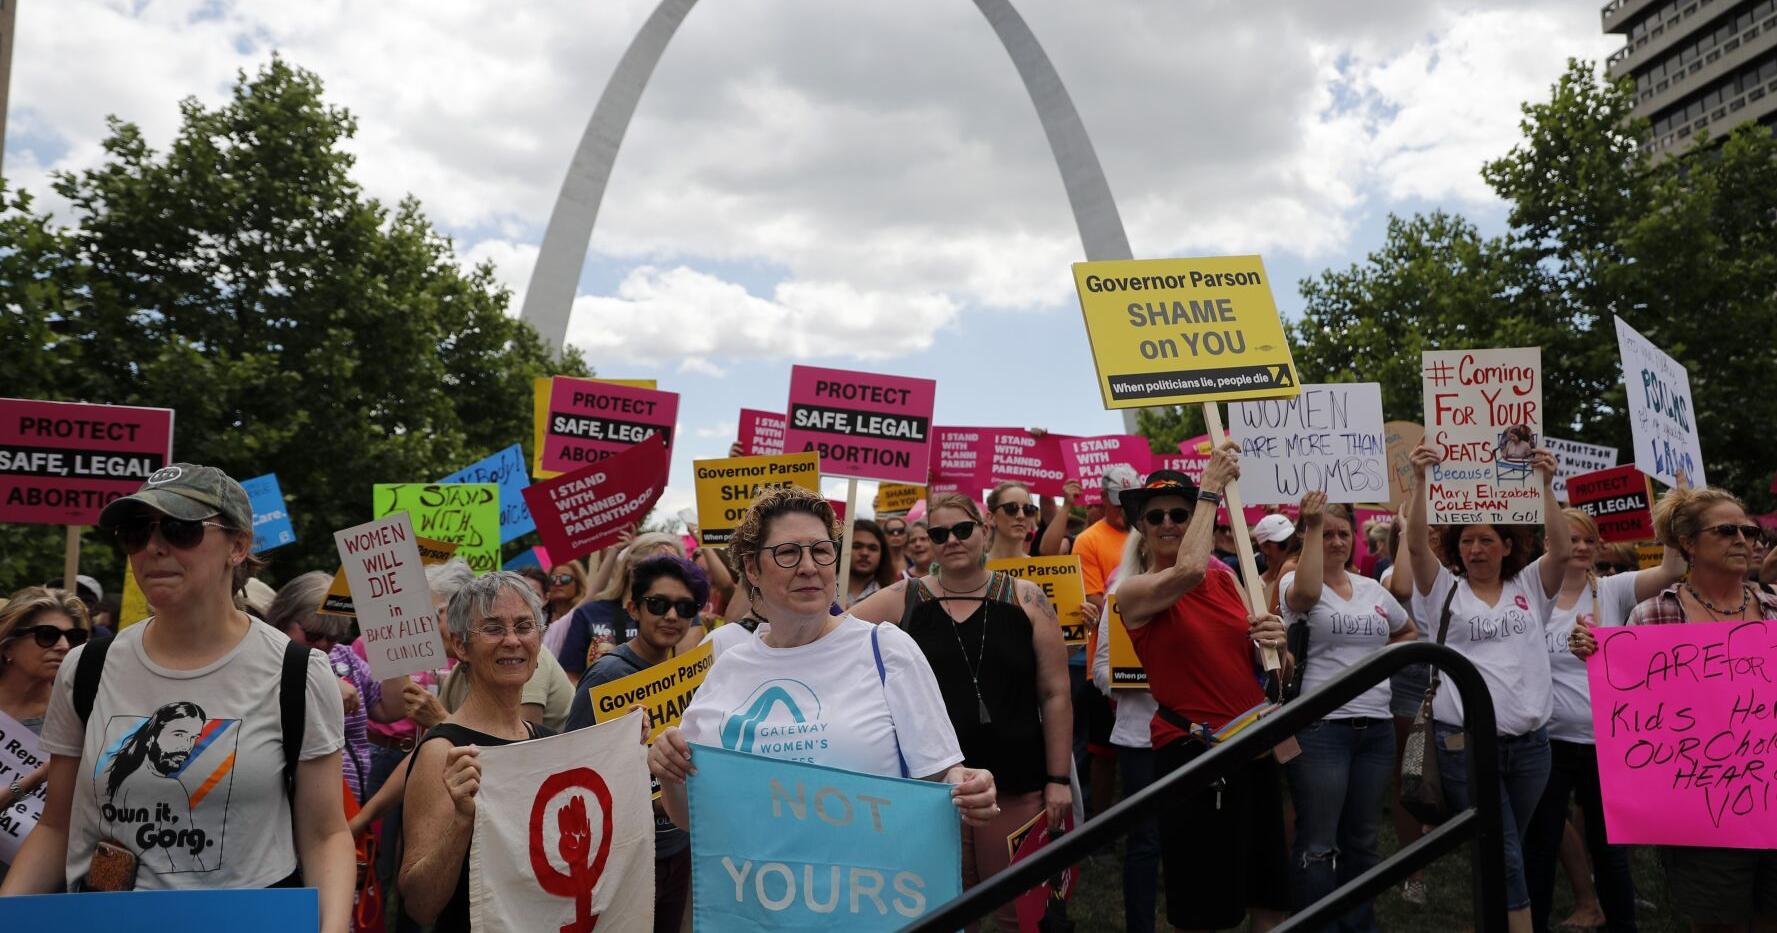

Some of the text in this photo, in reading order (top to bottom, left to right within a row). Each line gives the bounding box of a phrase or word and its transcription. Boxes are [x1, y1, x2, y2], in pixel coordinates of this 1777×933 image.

[1086, 271, 1262, 293] Governor Parson
[1127, 298, 1237, 327] SHAME
[1139, 330, 1246, 360] on YOU
[815, 380, 911, 406] PROTECT
[1113, 373, 1269, 394] When politicians lie, people die
[573, 391, 657, 416] PROTECT
[1241, 389, 1348, 430] WOMEN
[19, 416, 141, 442] PROTECT
[553, 416, 657, 443] SAFE, LEGA
[755, 427, 783, 438] WITH
[762, 418, 786, 429] STAN
[794, 408, 923, 439] SAFE, LEGAL
[942, 442, 967, 450] WITH
[948, 433, 979, 441] STAND
[995, 435, 1036, 447] I STAND
[1073, 439, 1120, 453] I STAND
[1242, 436, 1280, 459] ARE
[1285, 433, 1335, 457] MORE
[1340, 432, 1383, 456] THAN
[802, 441, 910, 469] ABORTION
[995, 444, 1023, 455] WITH
[1076, 452, 1110, 465] WITH
[1558, 442, 1611, 459] ABORTION
[0, 451, 153, 478] SAFE, LEGAL
[698, 462, 816, 480] Governor Parson
[992, 464, 1064, 480] PARENTHOOD
[993, 455, 1042, 468] PLANNED
[1164, 459, 1210, 470] I STAN
[1433, 463, 1494, 482] Because
[549, 472, 607, 500] I STAND
[1275, 456, 1384, 496] WOMBS
[1575, 476, 1629, 495] PROTECT
[382, 485, 493, 517] I STAND
[555, 490, 595, 511] WITH
[1429, 484, 1540, 503] Mary Elizabeth
[1599, 495, 1645, 514] LEGAL
[560, 492, 627, 524] PLANNED
[564, 487, 653, 536] PARENTHOOD
[1434, 499, 1509, 512] COLEMAN
[1435, 510, 1538, 523] NEEDS TO GO!
[421, 509, 471, 532] WITH
[344, 523, 406, 554] WOMEN
[704, 534, 723, 542] When
[362, 550, 403, 574] WILL
[1027, 564, 1077, 577] Parson
[368, 571, 402, 598] DIE
[389, 604, 403, 617] in
[366, 615, 434, 643] BACK ALLEY
[1330, 611, 1388, 636] 1973
[1468, 609, 1527, 642] 1973
[386, 641, 435, 662] CLINICS
[1545, 631, 1568, 653] 19
[600, 653, 714, 713] Governor Parson
[1115, 671, 1136, 680] When
[760, 723, 829, 738] GATEWAY
[5, 738, 44, 769] Reps
[760, 738, 829, 753] WOMEN'S
[1672, 759, 1764, 790] HEAR
[102, 802, 179, 825] Own it,
[769, 776, 891, 833] NOT
[1705, 782, 1777, 829] VOI
[136, 823, 214, 855] Gorg.
[721, 855, 927, 919] YOURS
